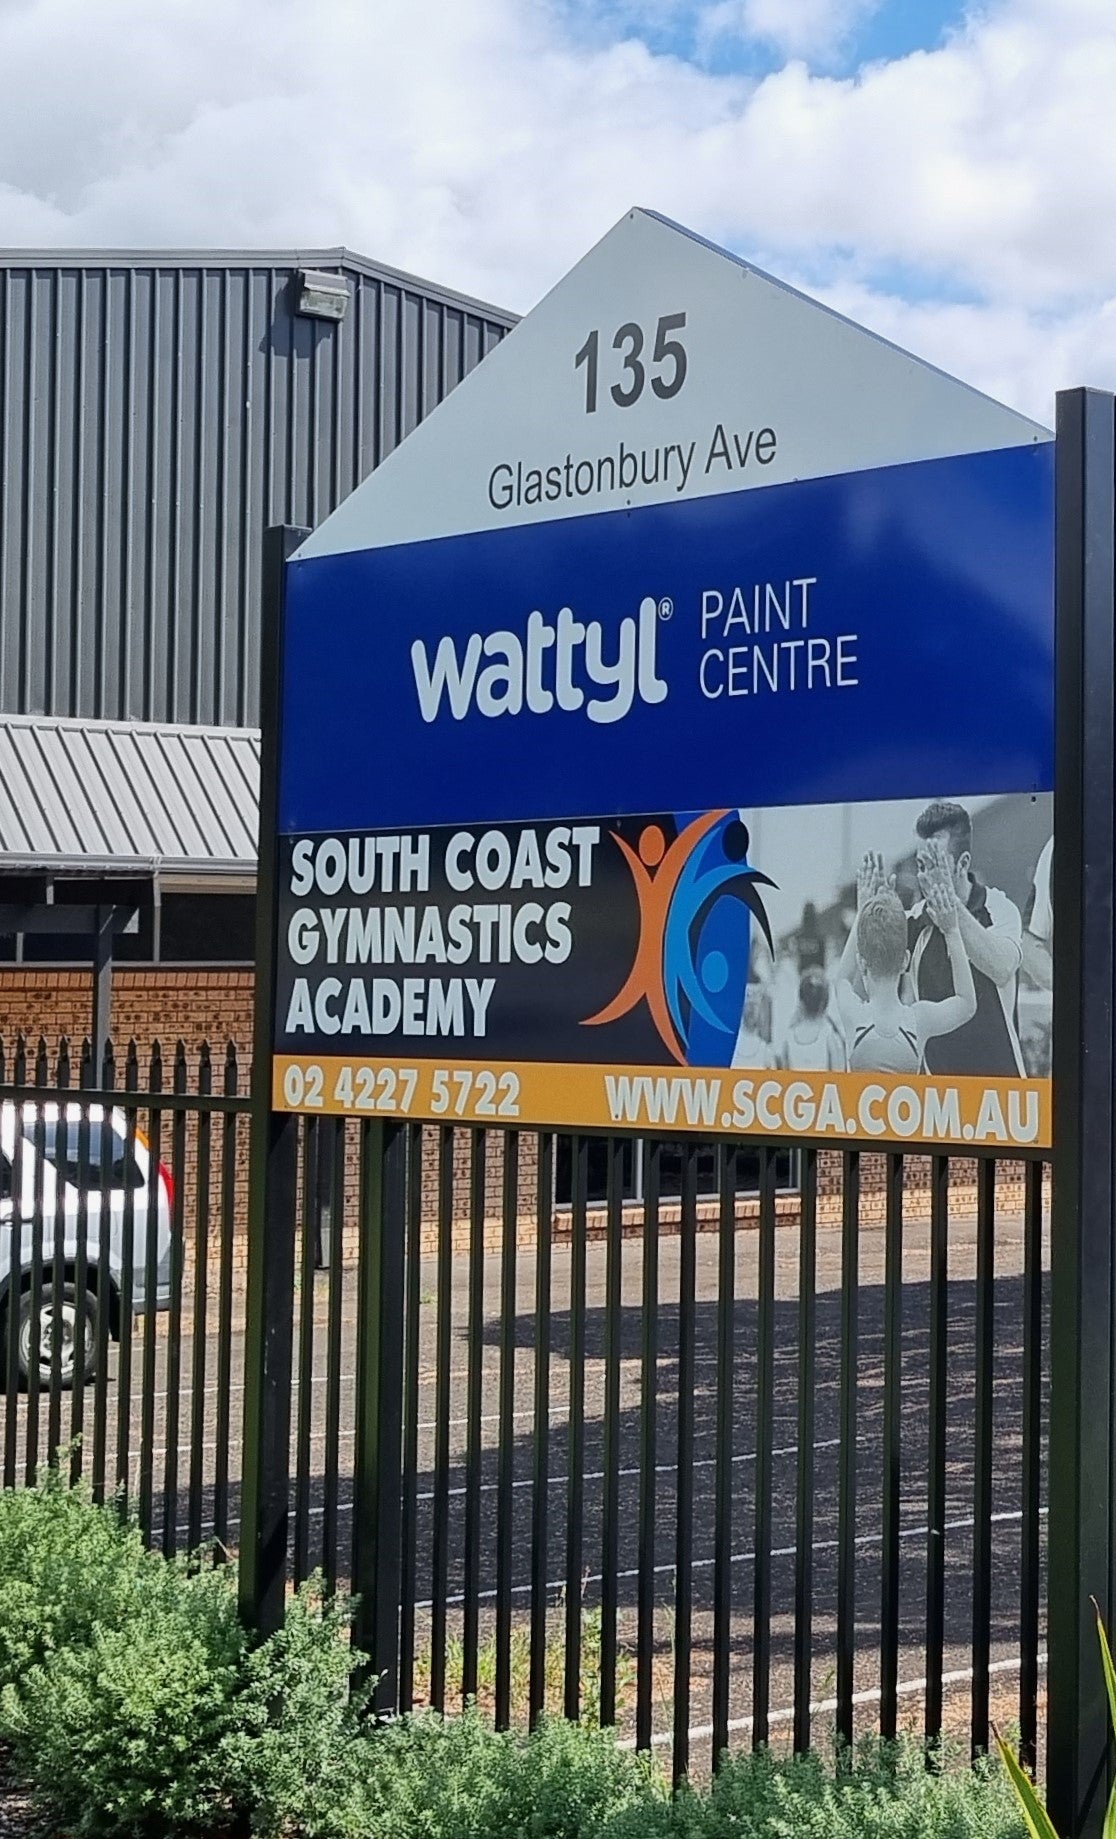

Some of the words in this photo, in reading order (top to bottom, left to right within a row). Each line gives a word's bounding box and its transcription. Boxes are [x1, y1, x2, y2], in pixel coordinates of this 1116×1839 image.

[574, 312, 688, 414] 135
[488, 441, 696, 509] Glastonbury
[705, 424, 777, 474] Ave
[701, 577, 817, 640] PAINT
[699, 634, 859, 699] CENTRE
[291, 834, 429, 896] SOUTH
[445, 826, 600, 891] COAST
[287, 902, 572, 964] GYMNASTICS
[285, 978, 496, 1037] ACADEMY
[283, 1065, 324, 1107] 02
[334, 1067, 420, 1114] 4227
[432, 1071, 520, 1116] 5722
[606, 1075, 1039, 1141] WWW.SCGA.COM.AU
